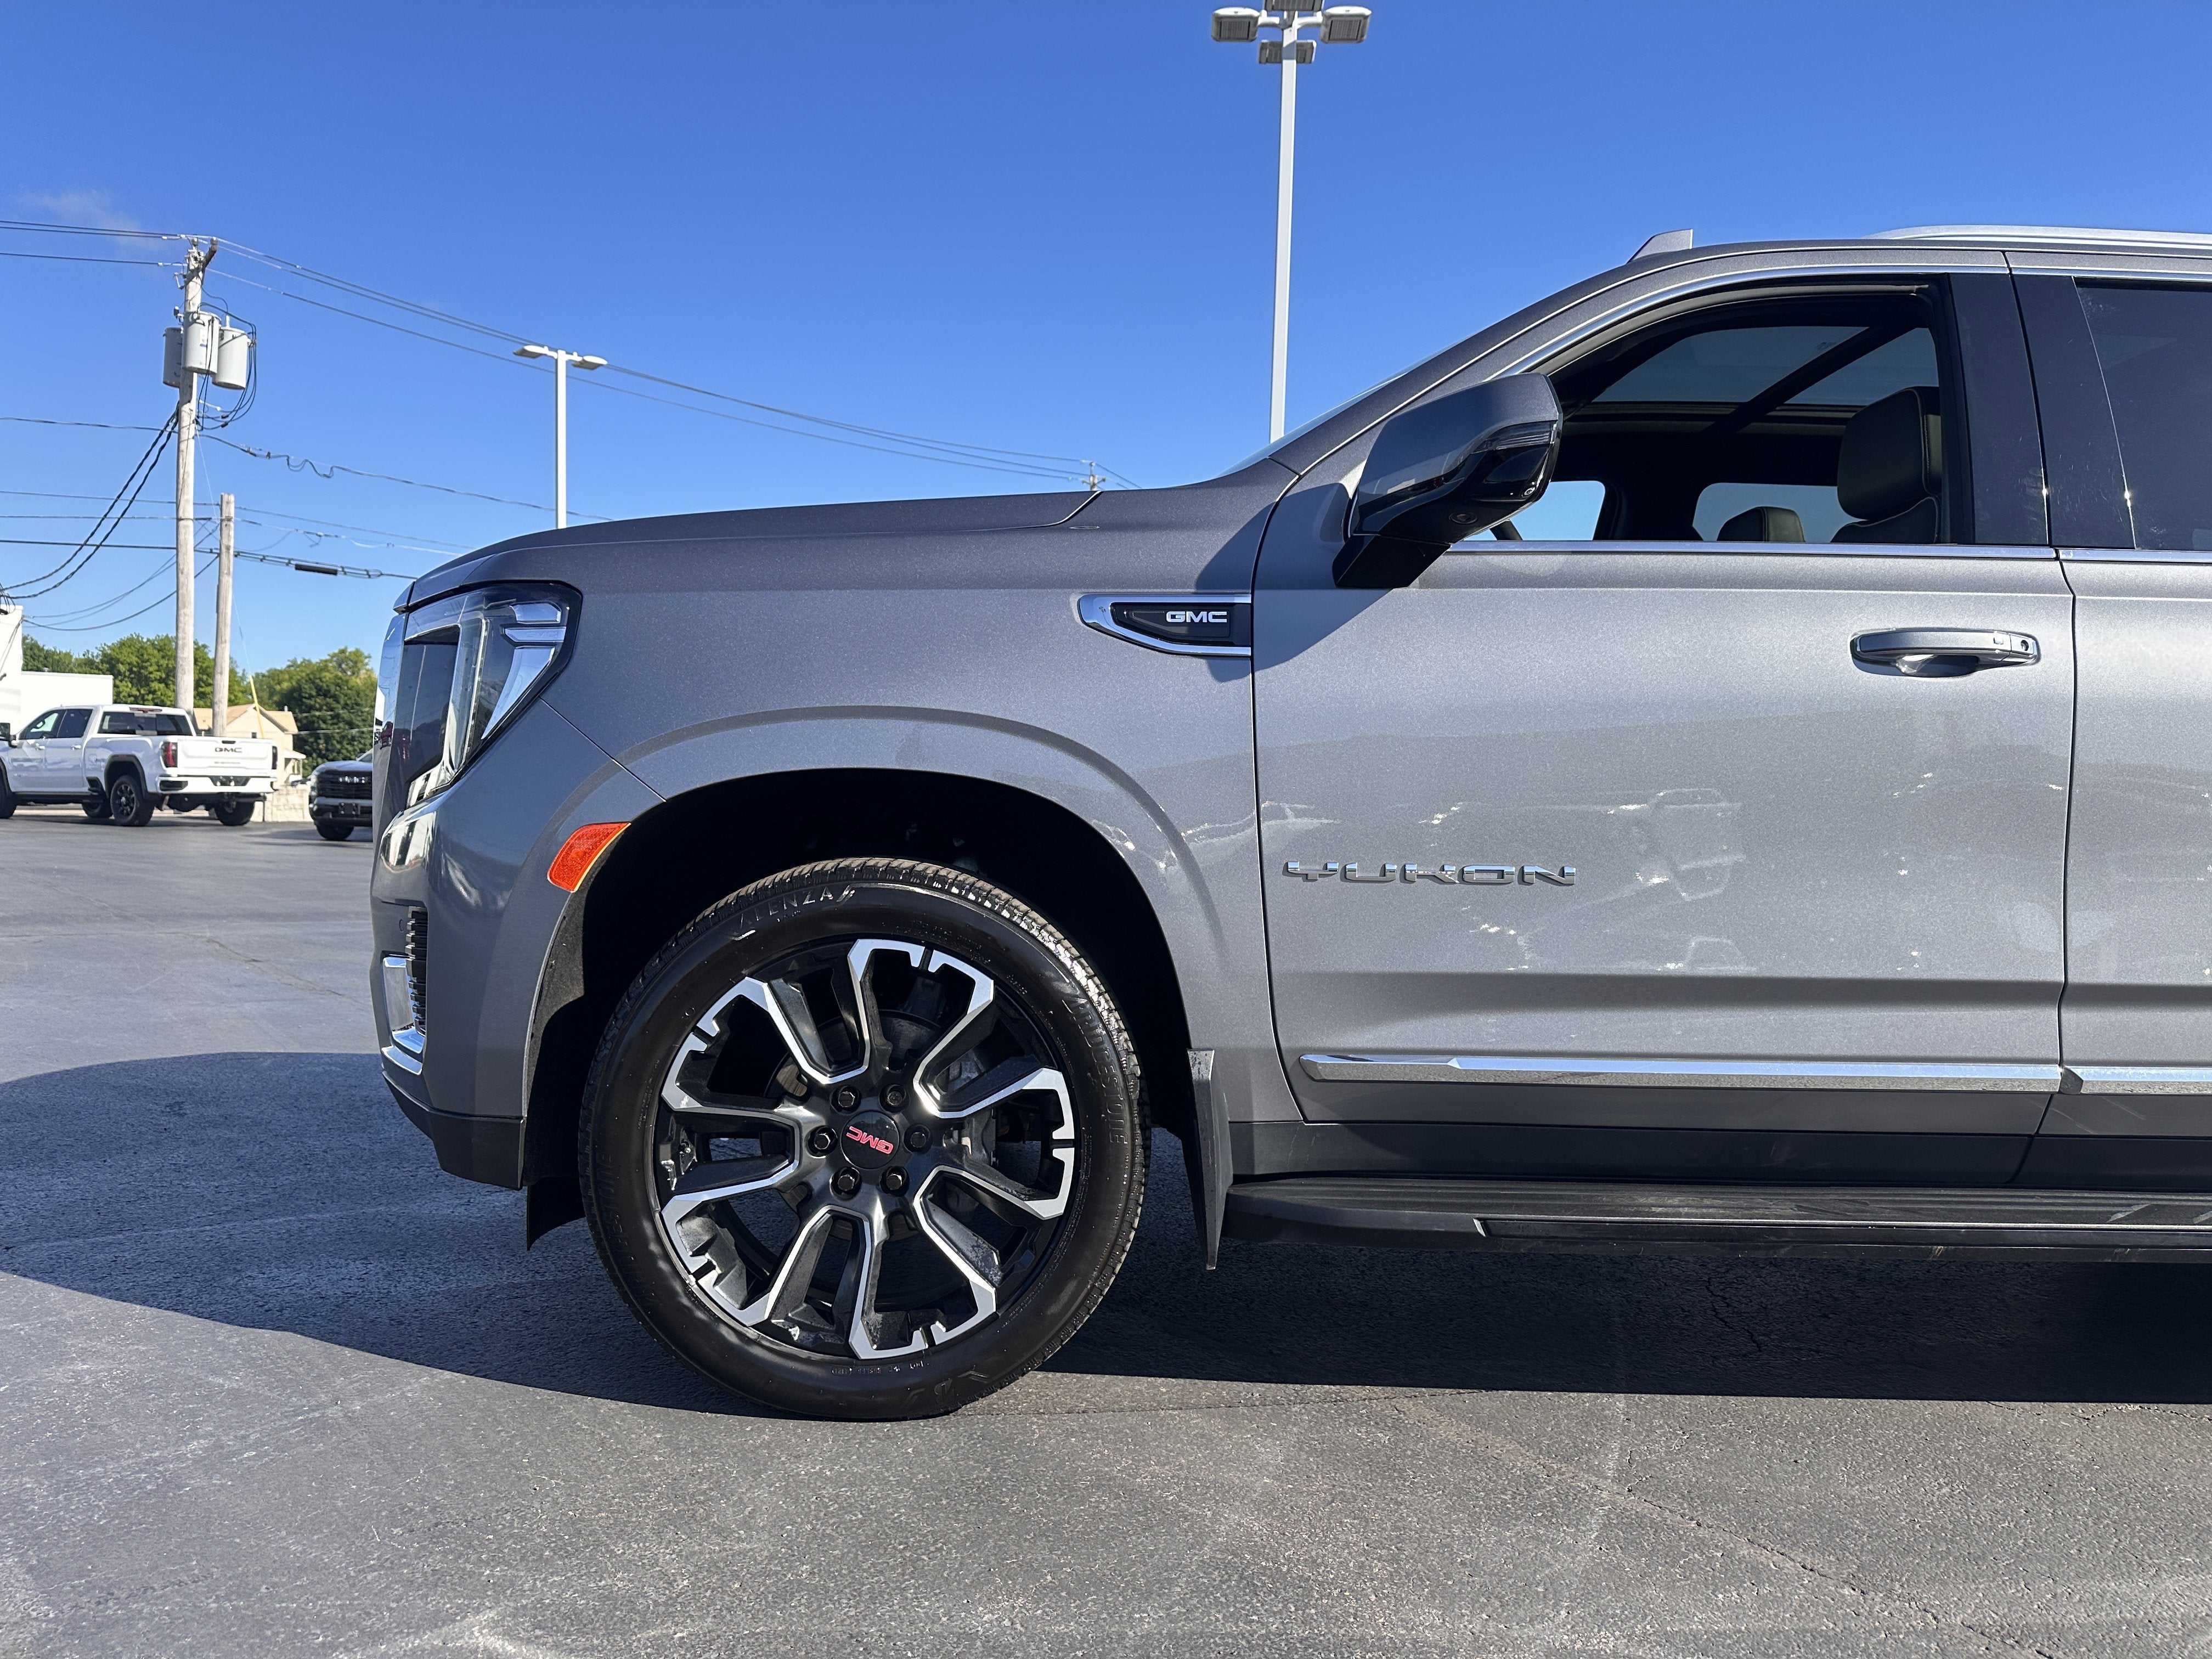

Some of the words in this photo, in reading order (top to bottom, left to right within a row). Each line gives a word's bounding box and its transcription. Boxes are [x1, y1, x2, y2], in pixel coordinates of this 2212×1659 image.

[1166, 611, 1228, 623] GMC
[1285, 861, 1576, 885] YUKON
[846, 1126, 894, 1154] GMC
